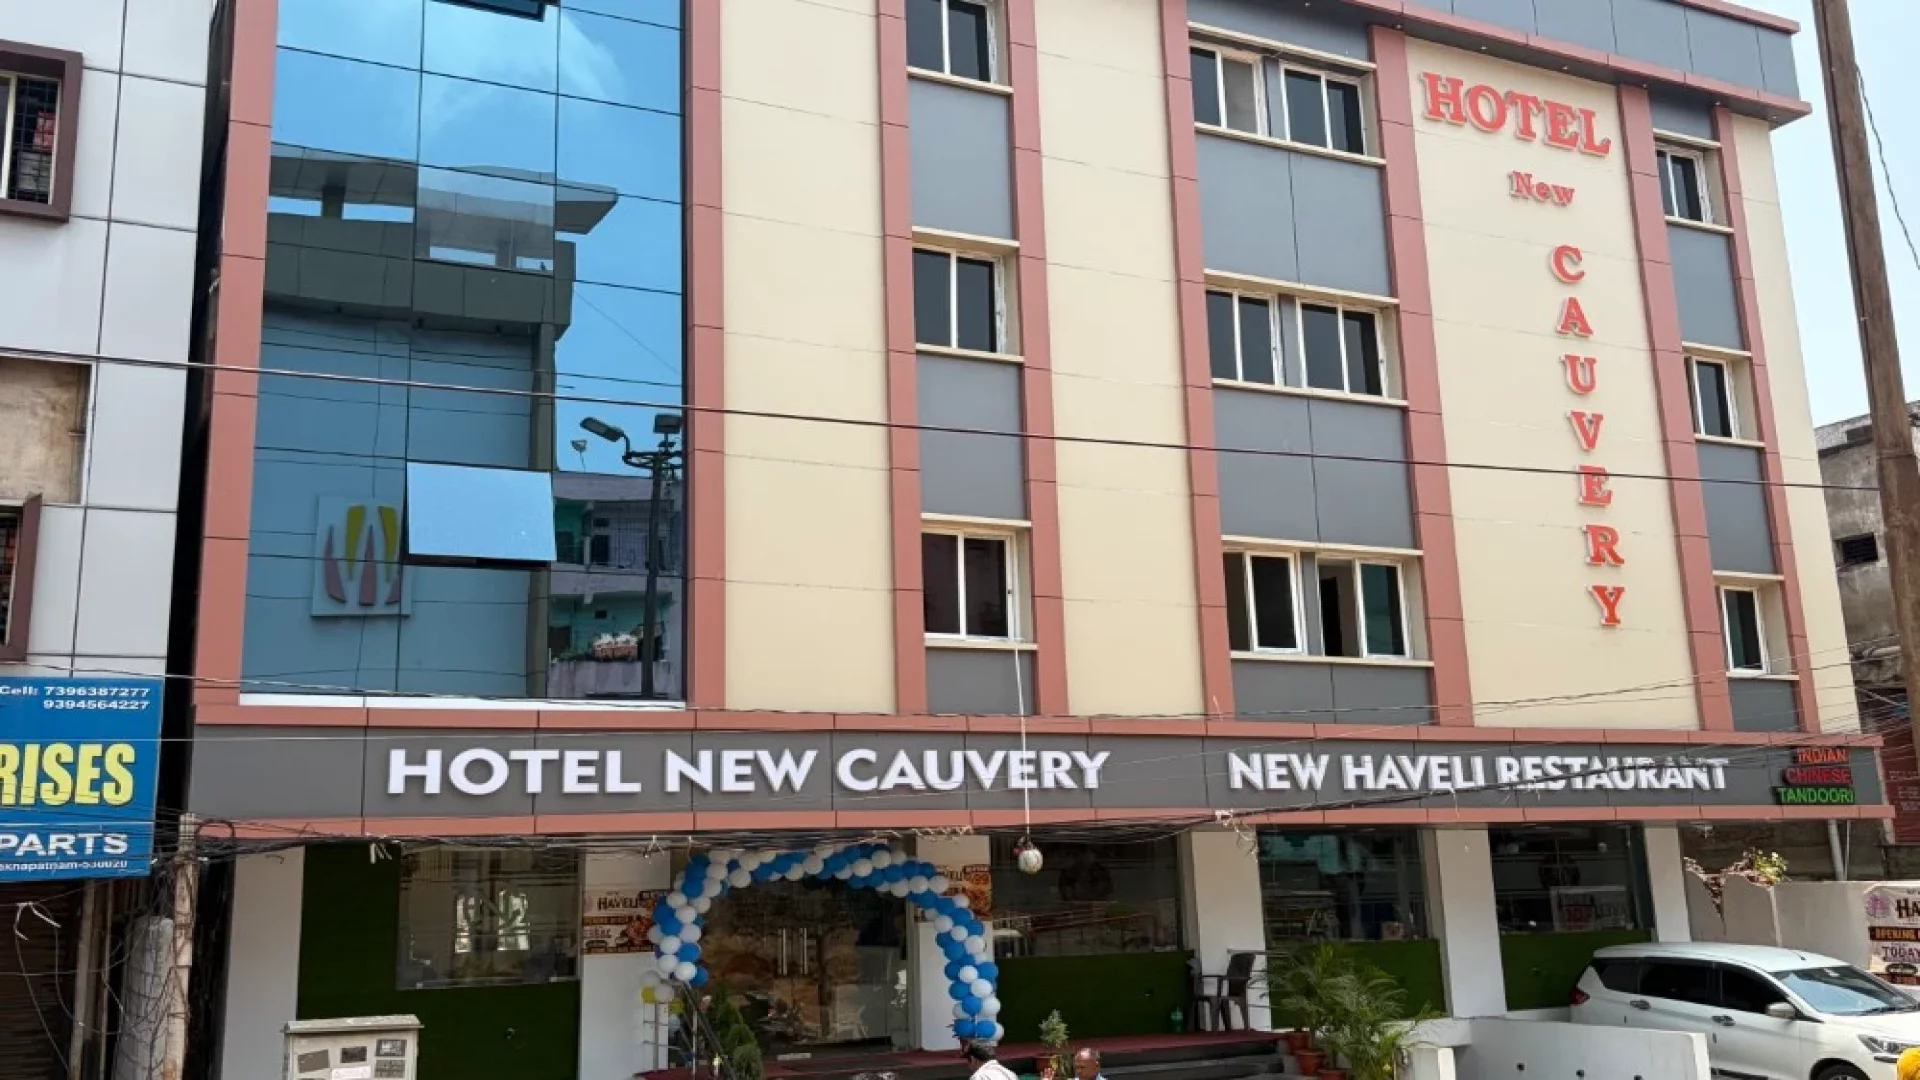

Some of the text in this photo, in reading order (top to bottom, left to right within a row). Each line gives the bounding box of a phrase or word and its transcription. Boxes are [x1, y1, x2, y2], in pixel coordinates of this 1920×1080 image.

[1420, 72, 1612, 157] HOTEL
[1508, 170, 1575, 206] New
[1549, 244, 1626, 628] CAUVERY
[43, 686, 150, 696] 7396387277
[43, 700, 149, 710] 9394564227
[1797, 748, 1847, 763] INDIAN
[0, 743, 135, 806] RISES
[387, 748, 1111, 795] HOTEL NEW CAUVERY
[1228, 752, 1730, 790] NEW HAVELI RESTAURANT
[1785, 767, 1851, 784] CHINESE
[1777, 787, 1854, 803] TANDOORI
[0, 832, 129, 856] PARTS
